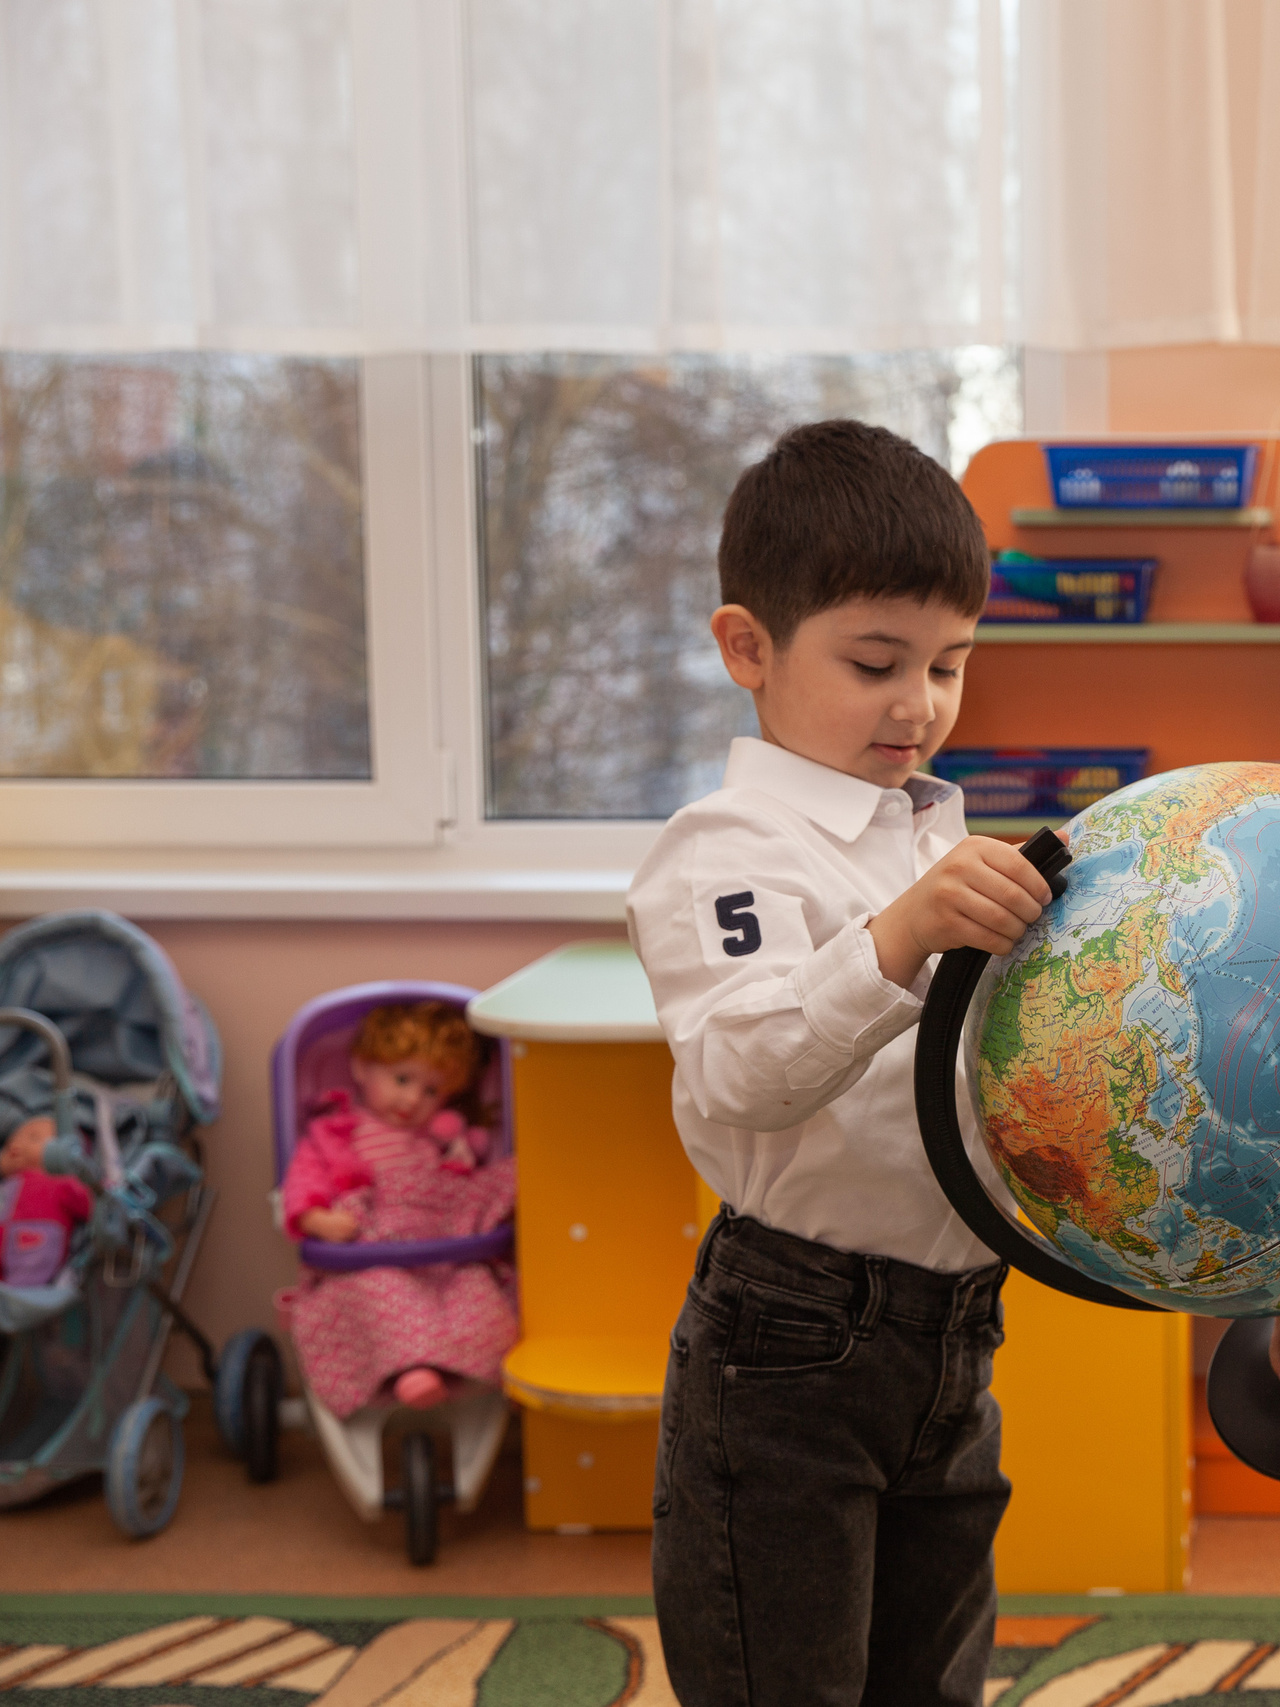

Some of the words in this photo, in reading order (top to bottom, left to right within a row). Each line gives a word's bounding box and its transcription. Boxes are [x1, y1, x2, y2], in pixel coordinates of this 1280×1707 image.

[715, 890, 762, 957] 5
[1136, 991, 1162, 1015] ОХОТСКОЕ
[1151, 1001, 1165, 1014] МОРЕ
